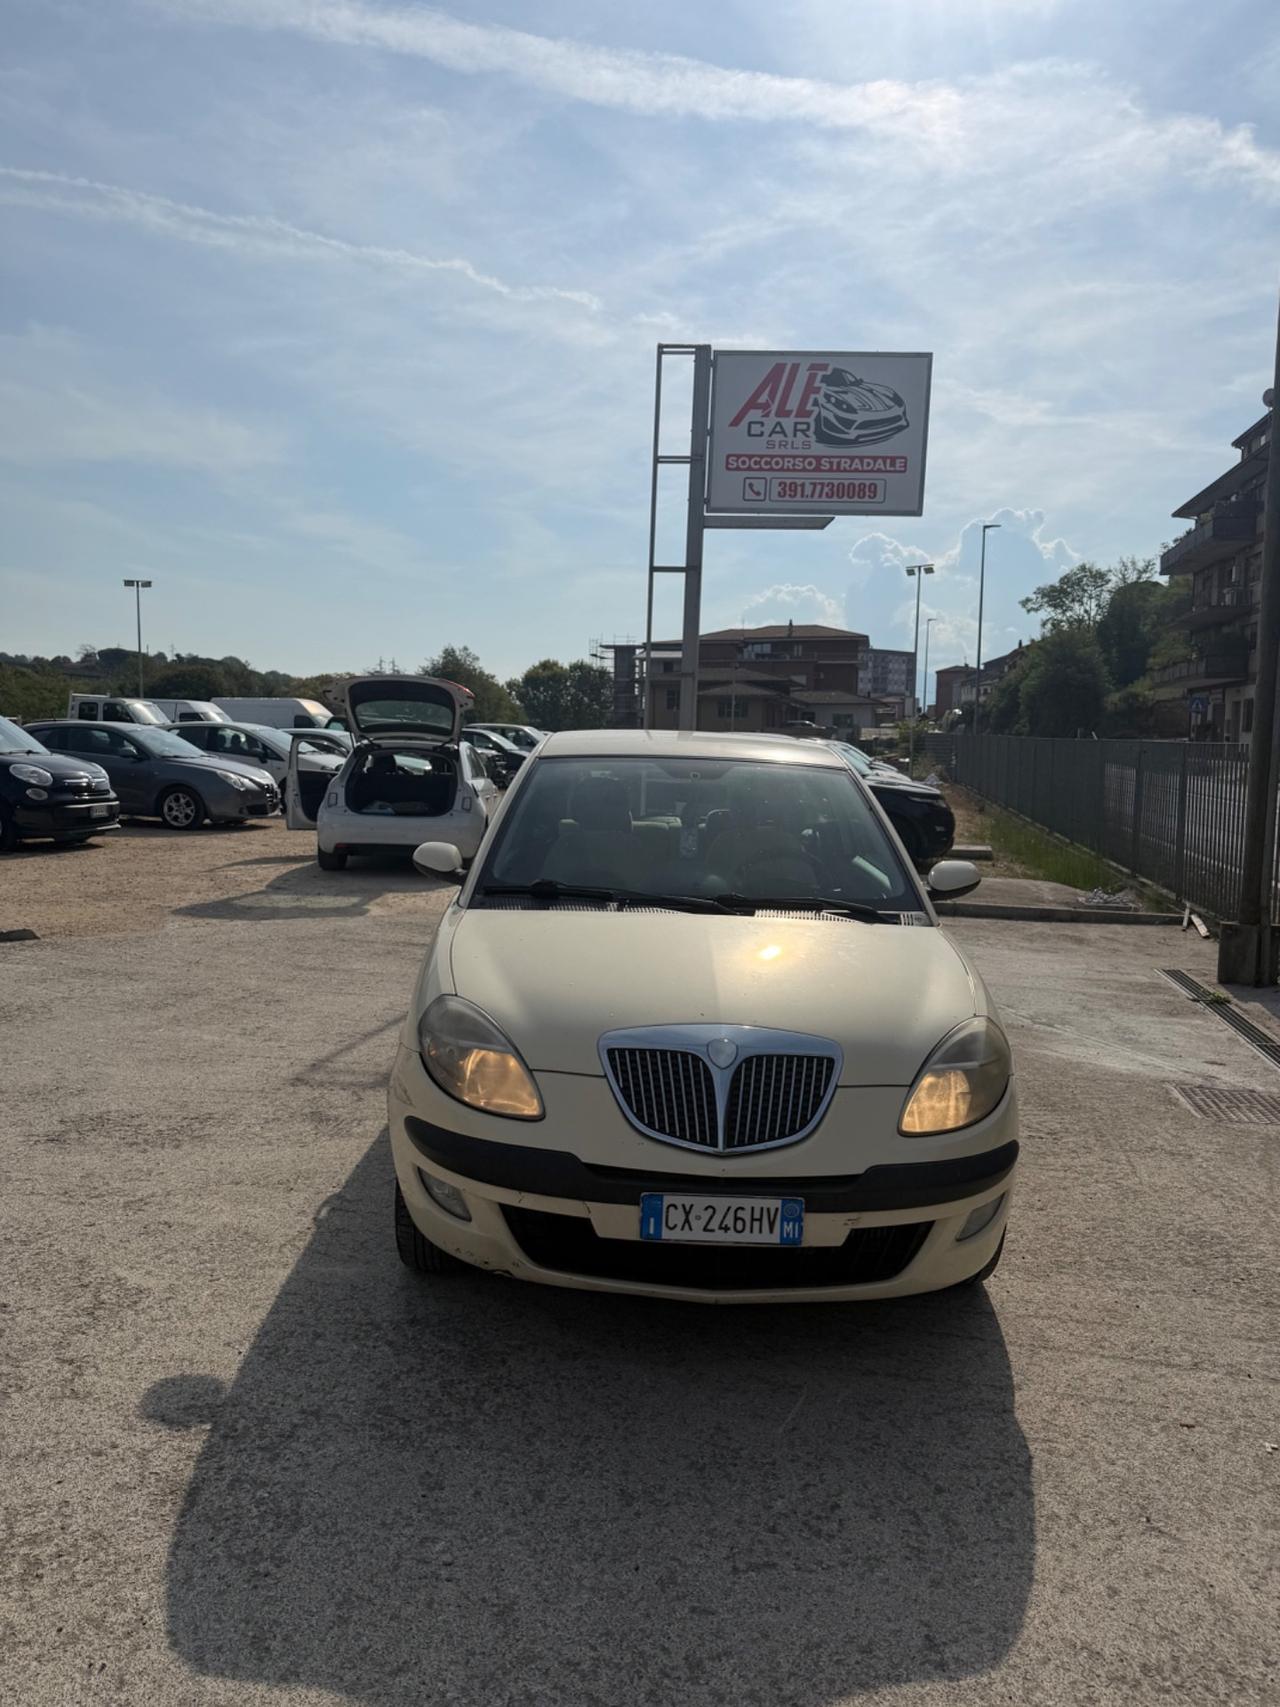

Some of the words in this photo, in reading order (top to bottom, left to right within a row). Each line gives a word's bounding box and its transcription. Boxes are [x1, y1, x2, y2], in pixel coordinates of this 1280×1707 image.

[728, 362, 830, 428] ALE
[747, 420, 811, 438] CAR
[766, 440, 812, 450] SRLS
[727, 456, 816, 470] SOCCORSO
[819, 458, 905, 471] STRADALE
[777, 481, 878, 499] 391.7730089
[783, 1221, 799, 1238] MI
